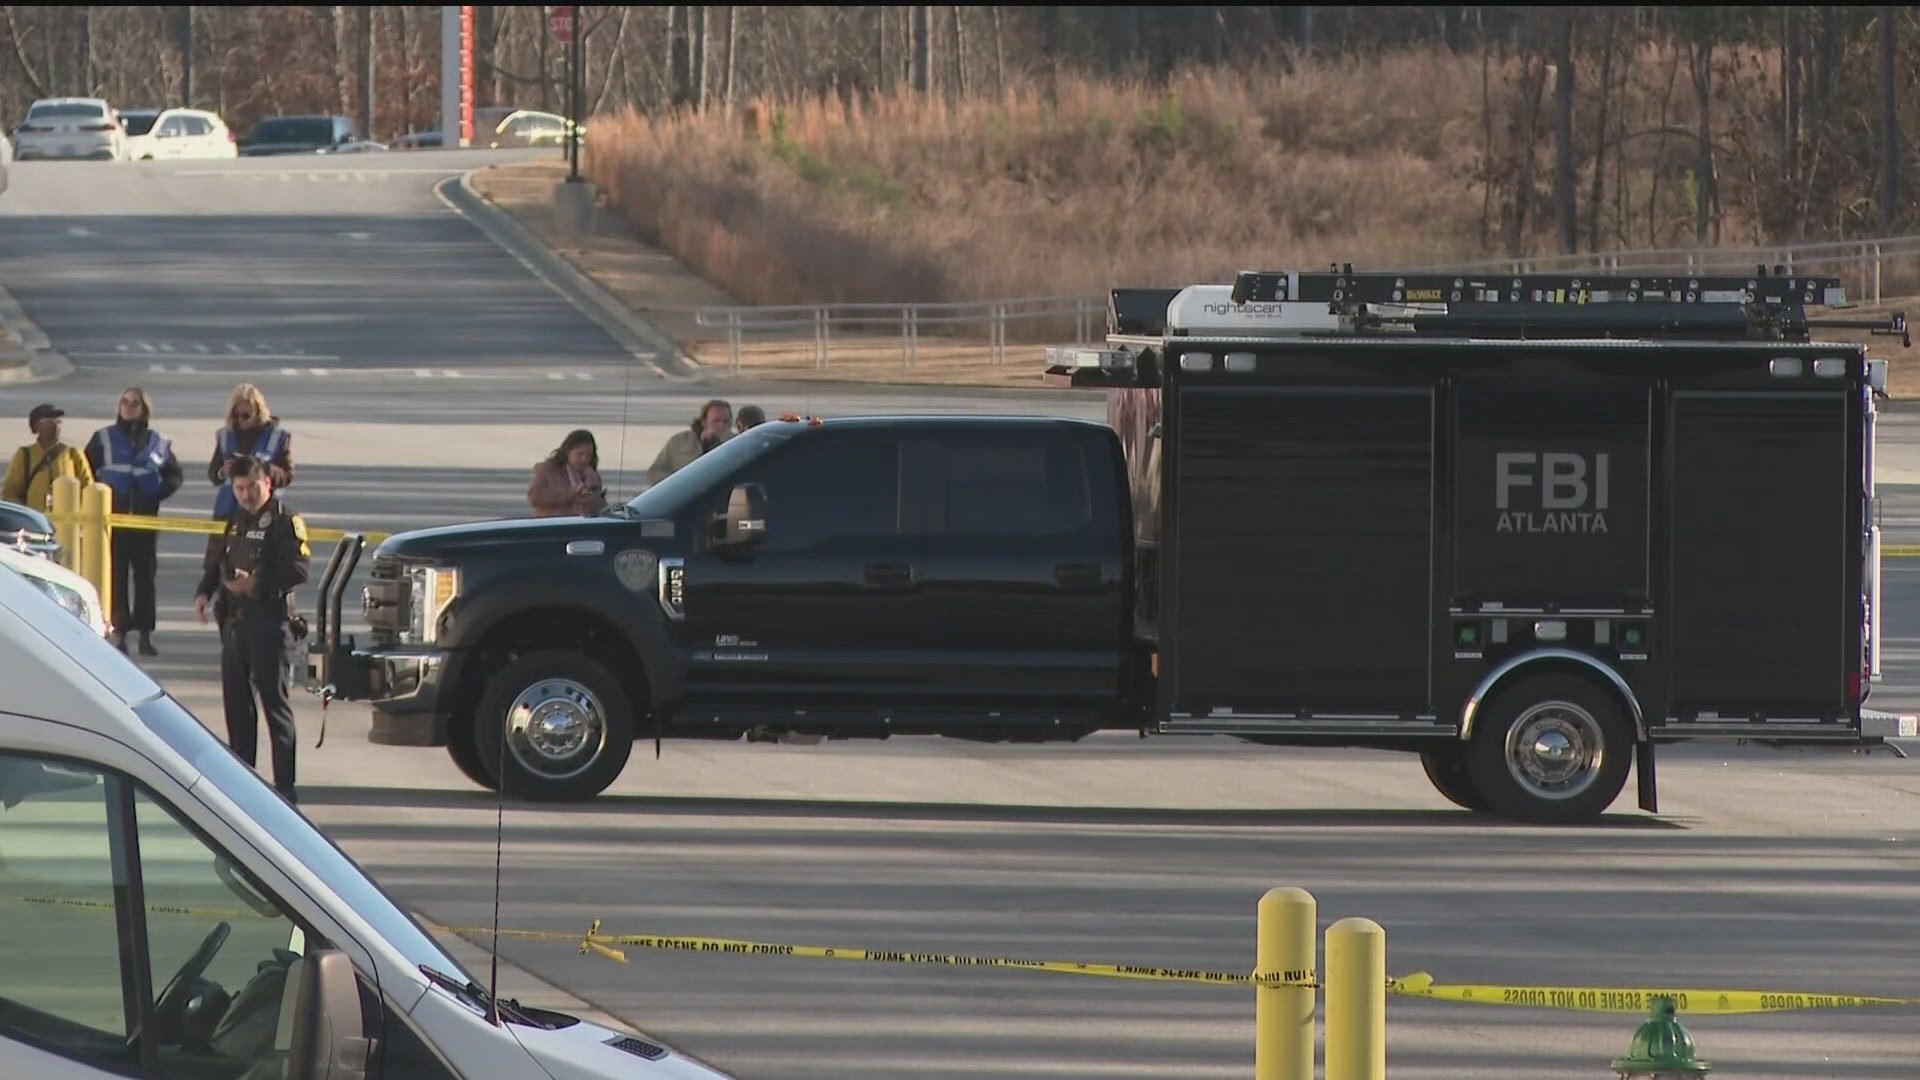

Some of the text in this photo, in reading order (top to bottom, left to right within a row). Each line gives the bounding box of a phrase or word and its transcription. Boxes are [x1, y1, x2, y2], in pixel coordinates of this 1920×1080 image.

[1204, 302, 1282, 315] nightscan
[1496, 453, 1608, 508] FBI
[1496, 512, 1608, 532] ATLANTA
